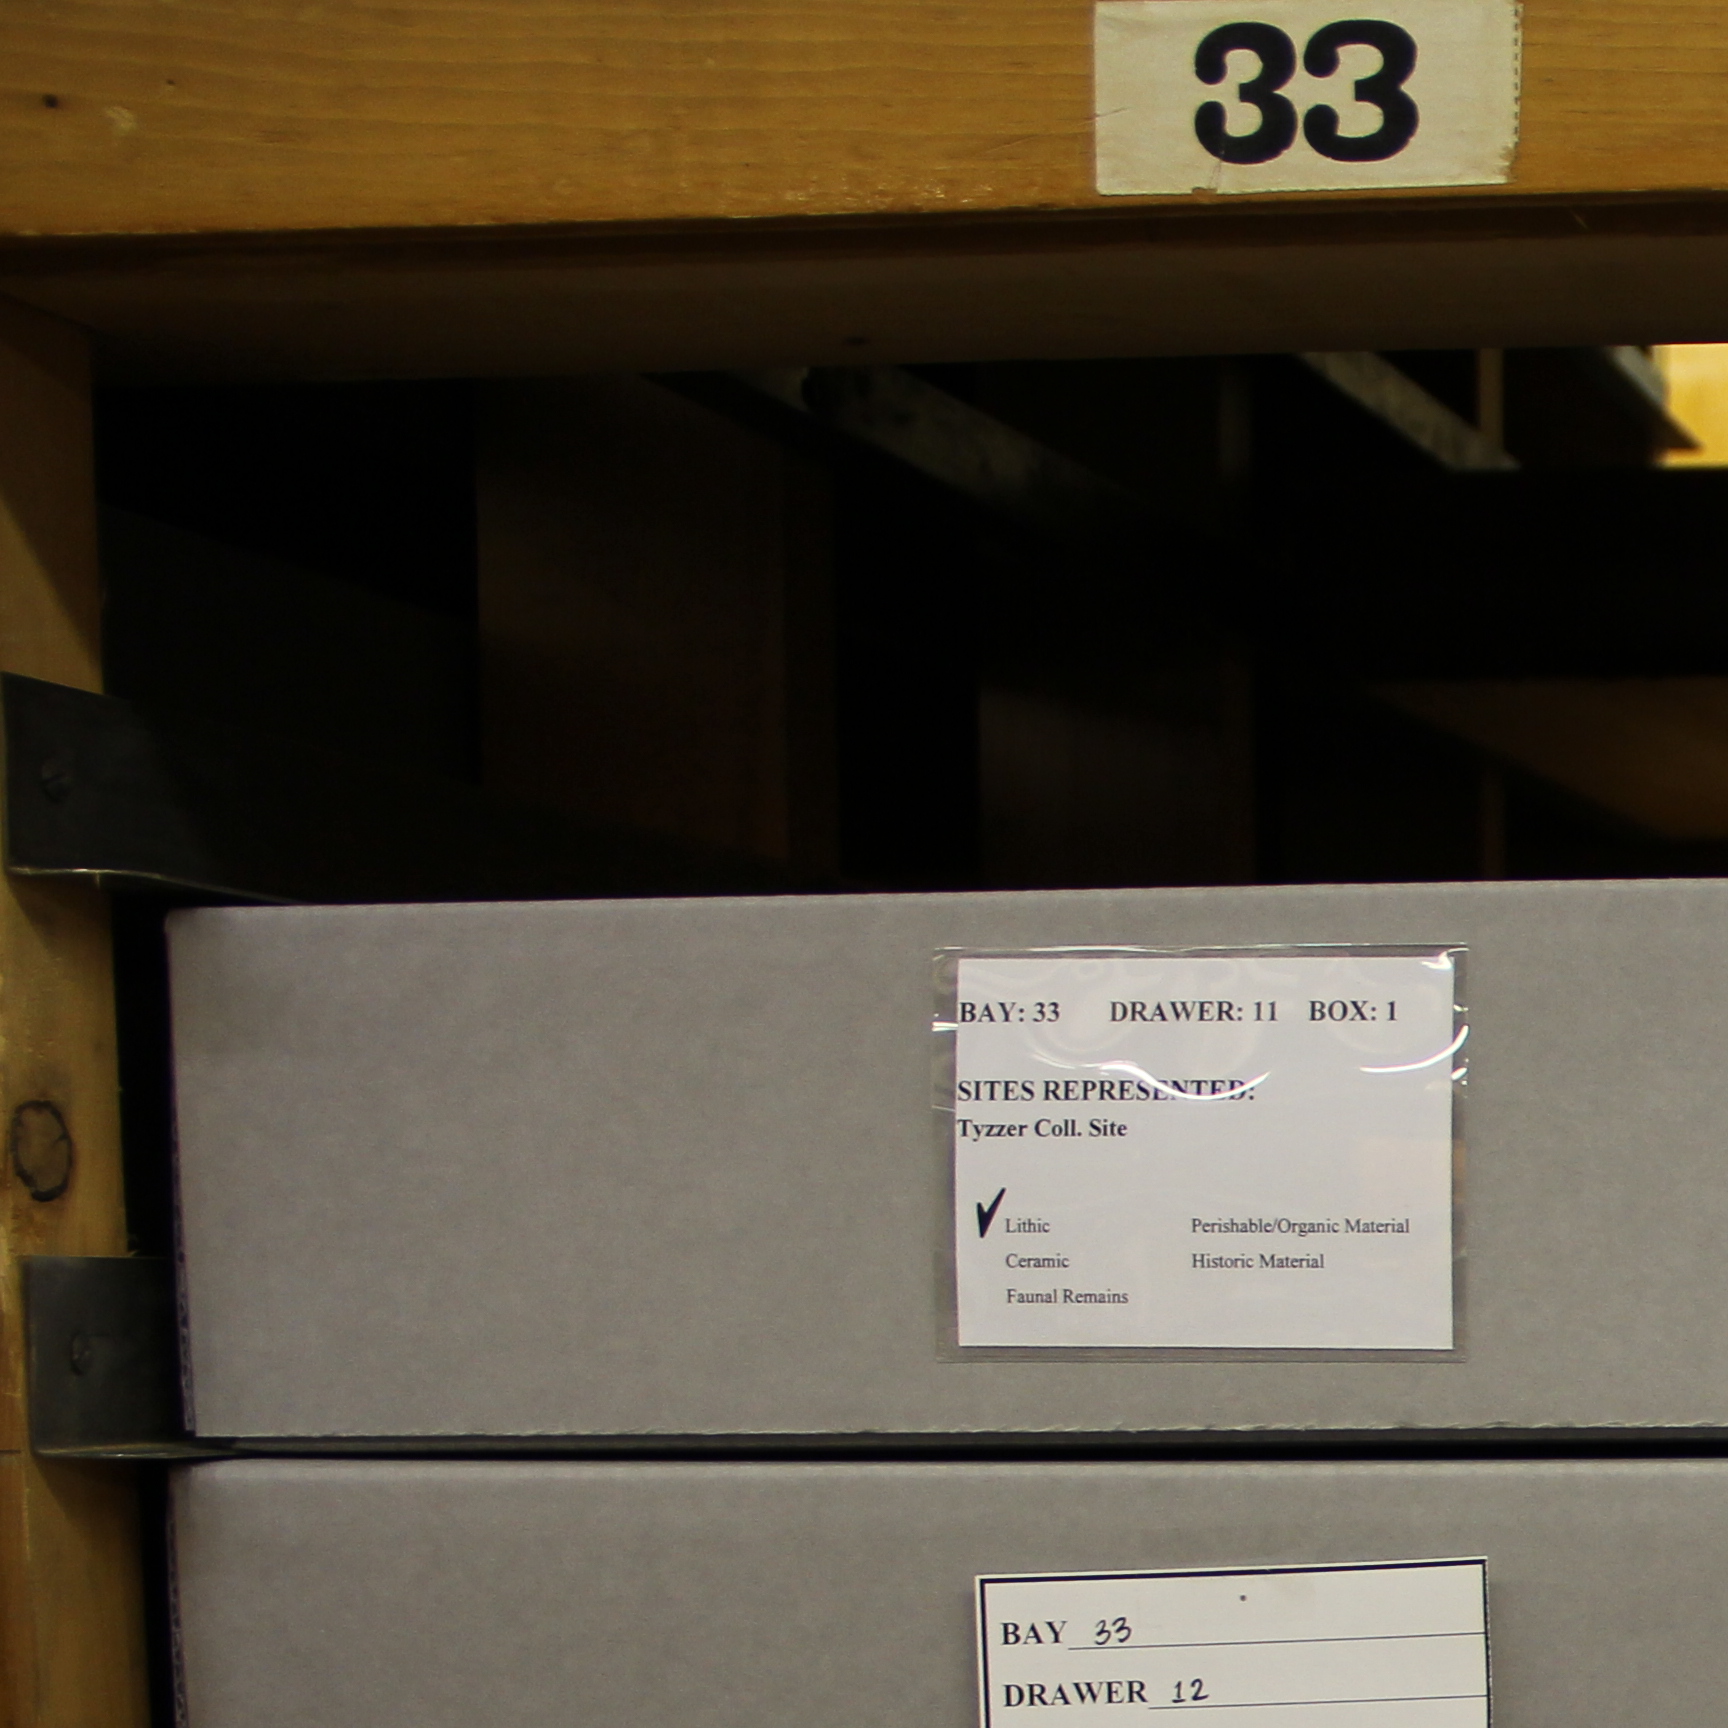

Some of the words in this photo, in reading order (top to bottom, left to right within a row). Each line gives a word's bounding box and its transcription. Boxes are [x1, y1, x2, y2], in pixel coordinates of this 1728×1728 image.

[1194, 19, 1419, 164] 33
[959, 1002, 1026, 1023] BAY:
[1033, 1001, 1061, 1023] 33
[1109, 1001, 1244, 1022] DRAWER:
[1253, 1001, 1278, 1021] 11
[1309, 1001, 1377, 1021] BOX:
[1386, 1001, 1398, 1021] 1
[957, 1080, 1035, 1102] SITES
[1043, 1080, 1256, 1102] REPRESENTED:
[957, 1119, 1028, 1141] Tyzzer
[1034, 1119, 1082, 1138] Coll.
[1088, 1119, 1128, 1137] Site
[1005, 1218, 1051, 1234] Lithic
[1192, 1253, 1254, 1269] Historic
[1259, 1253, 1325, 1269] Material
[1000, 1620, 1068, 1646] BAY
[1093, 1616, 1132, 1645] 33
[1003, 1680, 1149, 1708] DRAWER
[1171, 1678, 1209, 1703] 12
